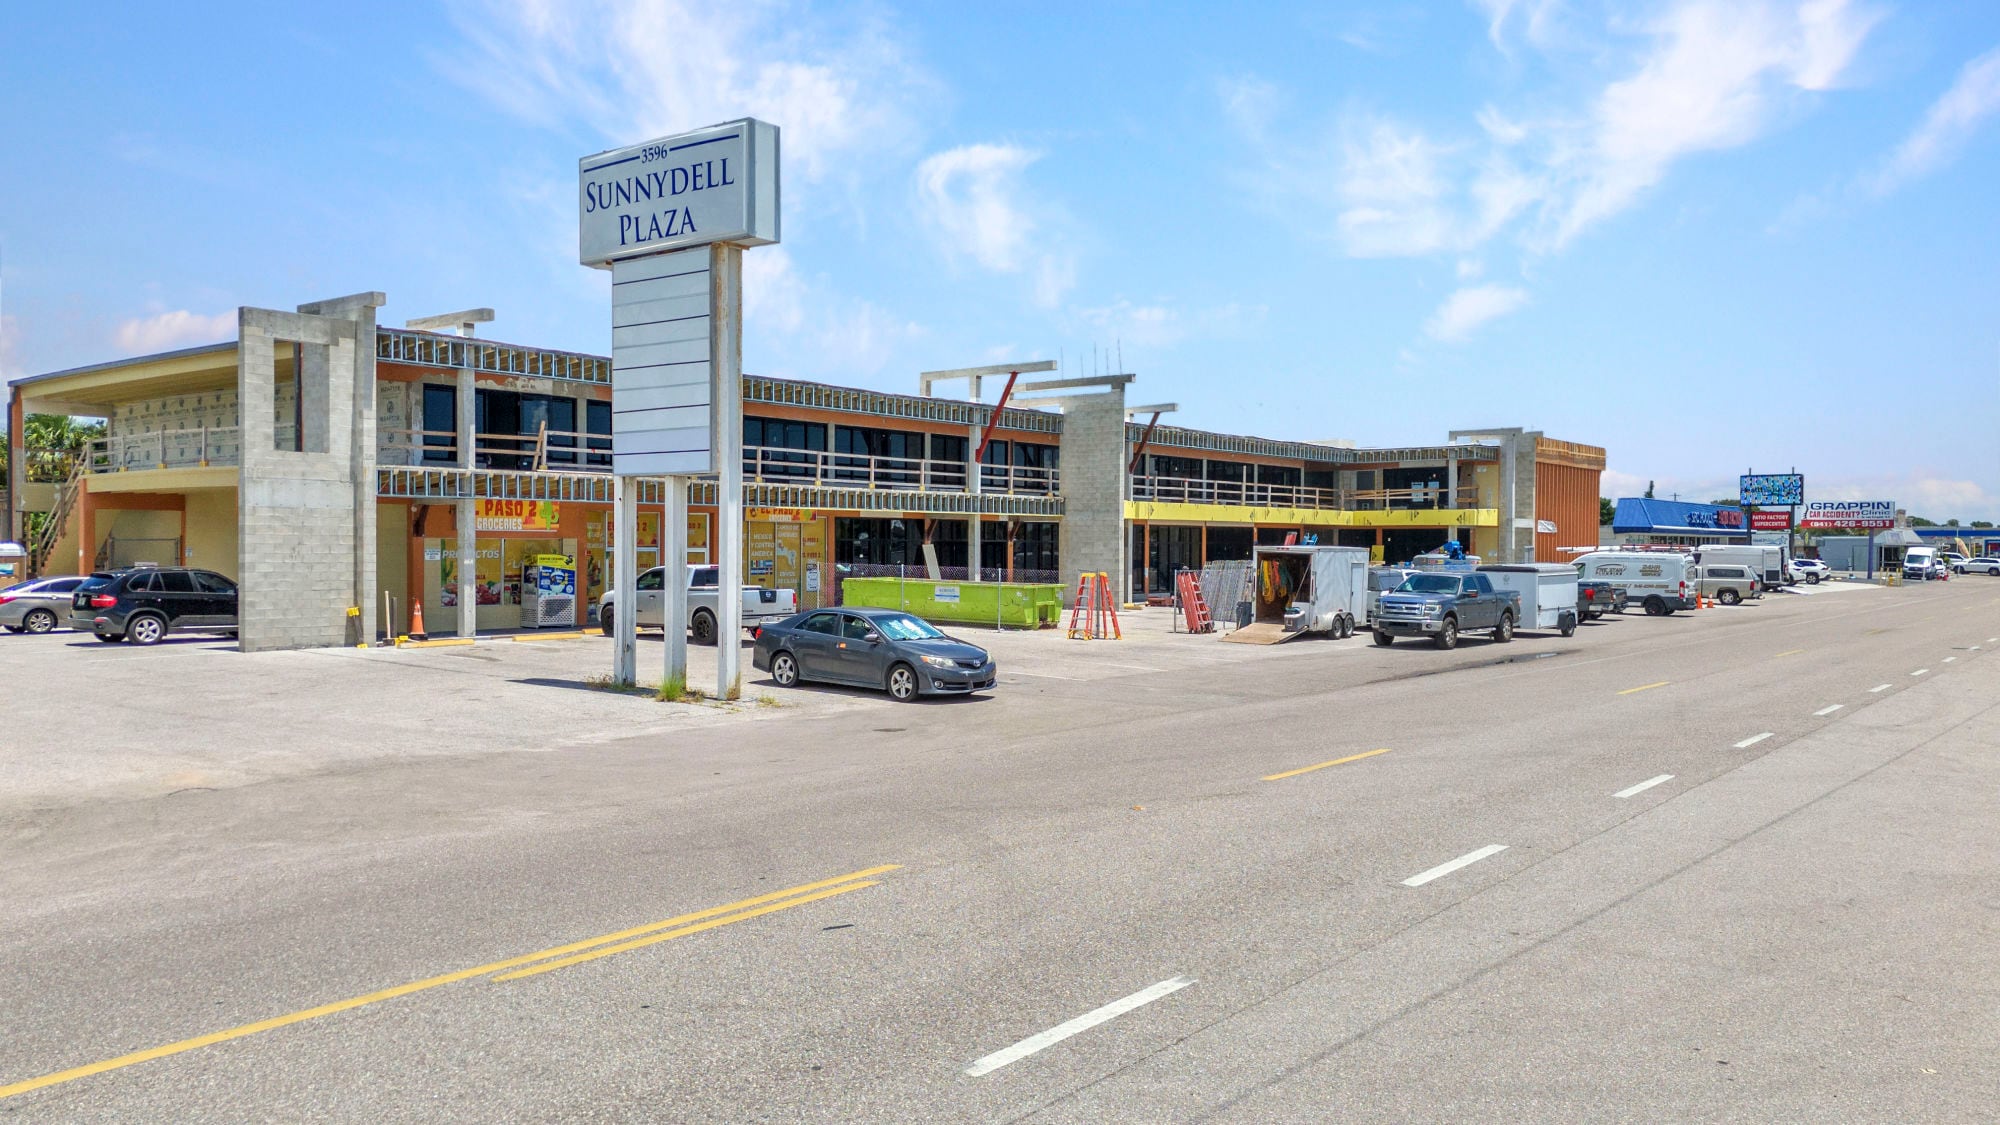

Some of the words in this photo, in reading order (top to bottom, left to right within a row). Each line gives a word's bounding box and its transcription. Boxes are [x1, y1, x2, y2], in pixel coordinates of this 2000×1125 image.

[641, 143, 668, 164] 3596
[586, 157, 735, 213] SUNNYDELL
[619, 206, 697, 246] PLAZA
[484, 500, 524, 517] PASO
[528, 500, 537, 517] 2
[1810, 501, 1890, 511] GRAPPIN
[1809, 510, 1820, 518] CAR
[1822, 510, 1860, 518] ACCIDENT?
[477, 517, 523, 530] GROCERIES
[442, 550, 500, 559] PRCTOS
